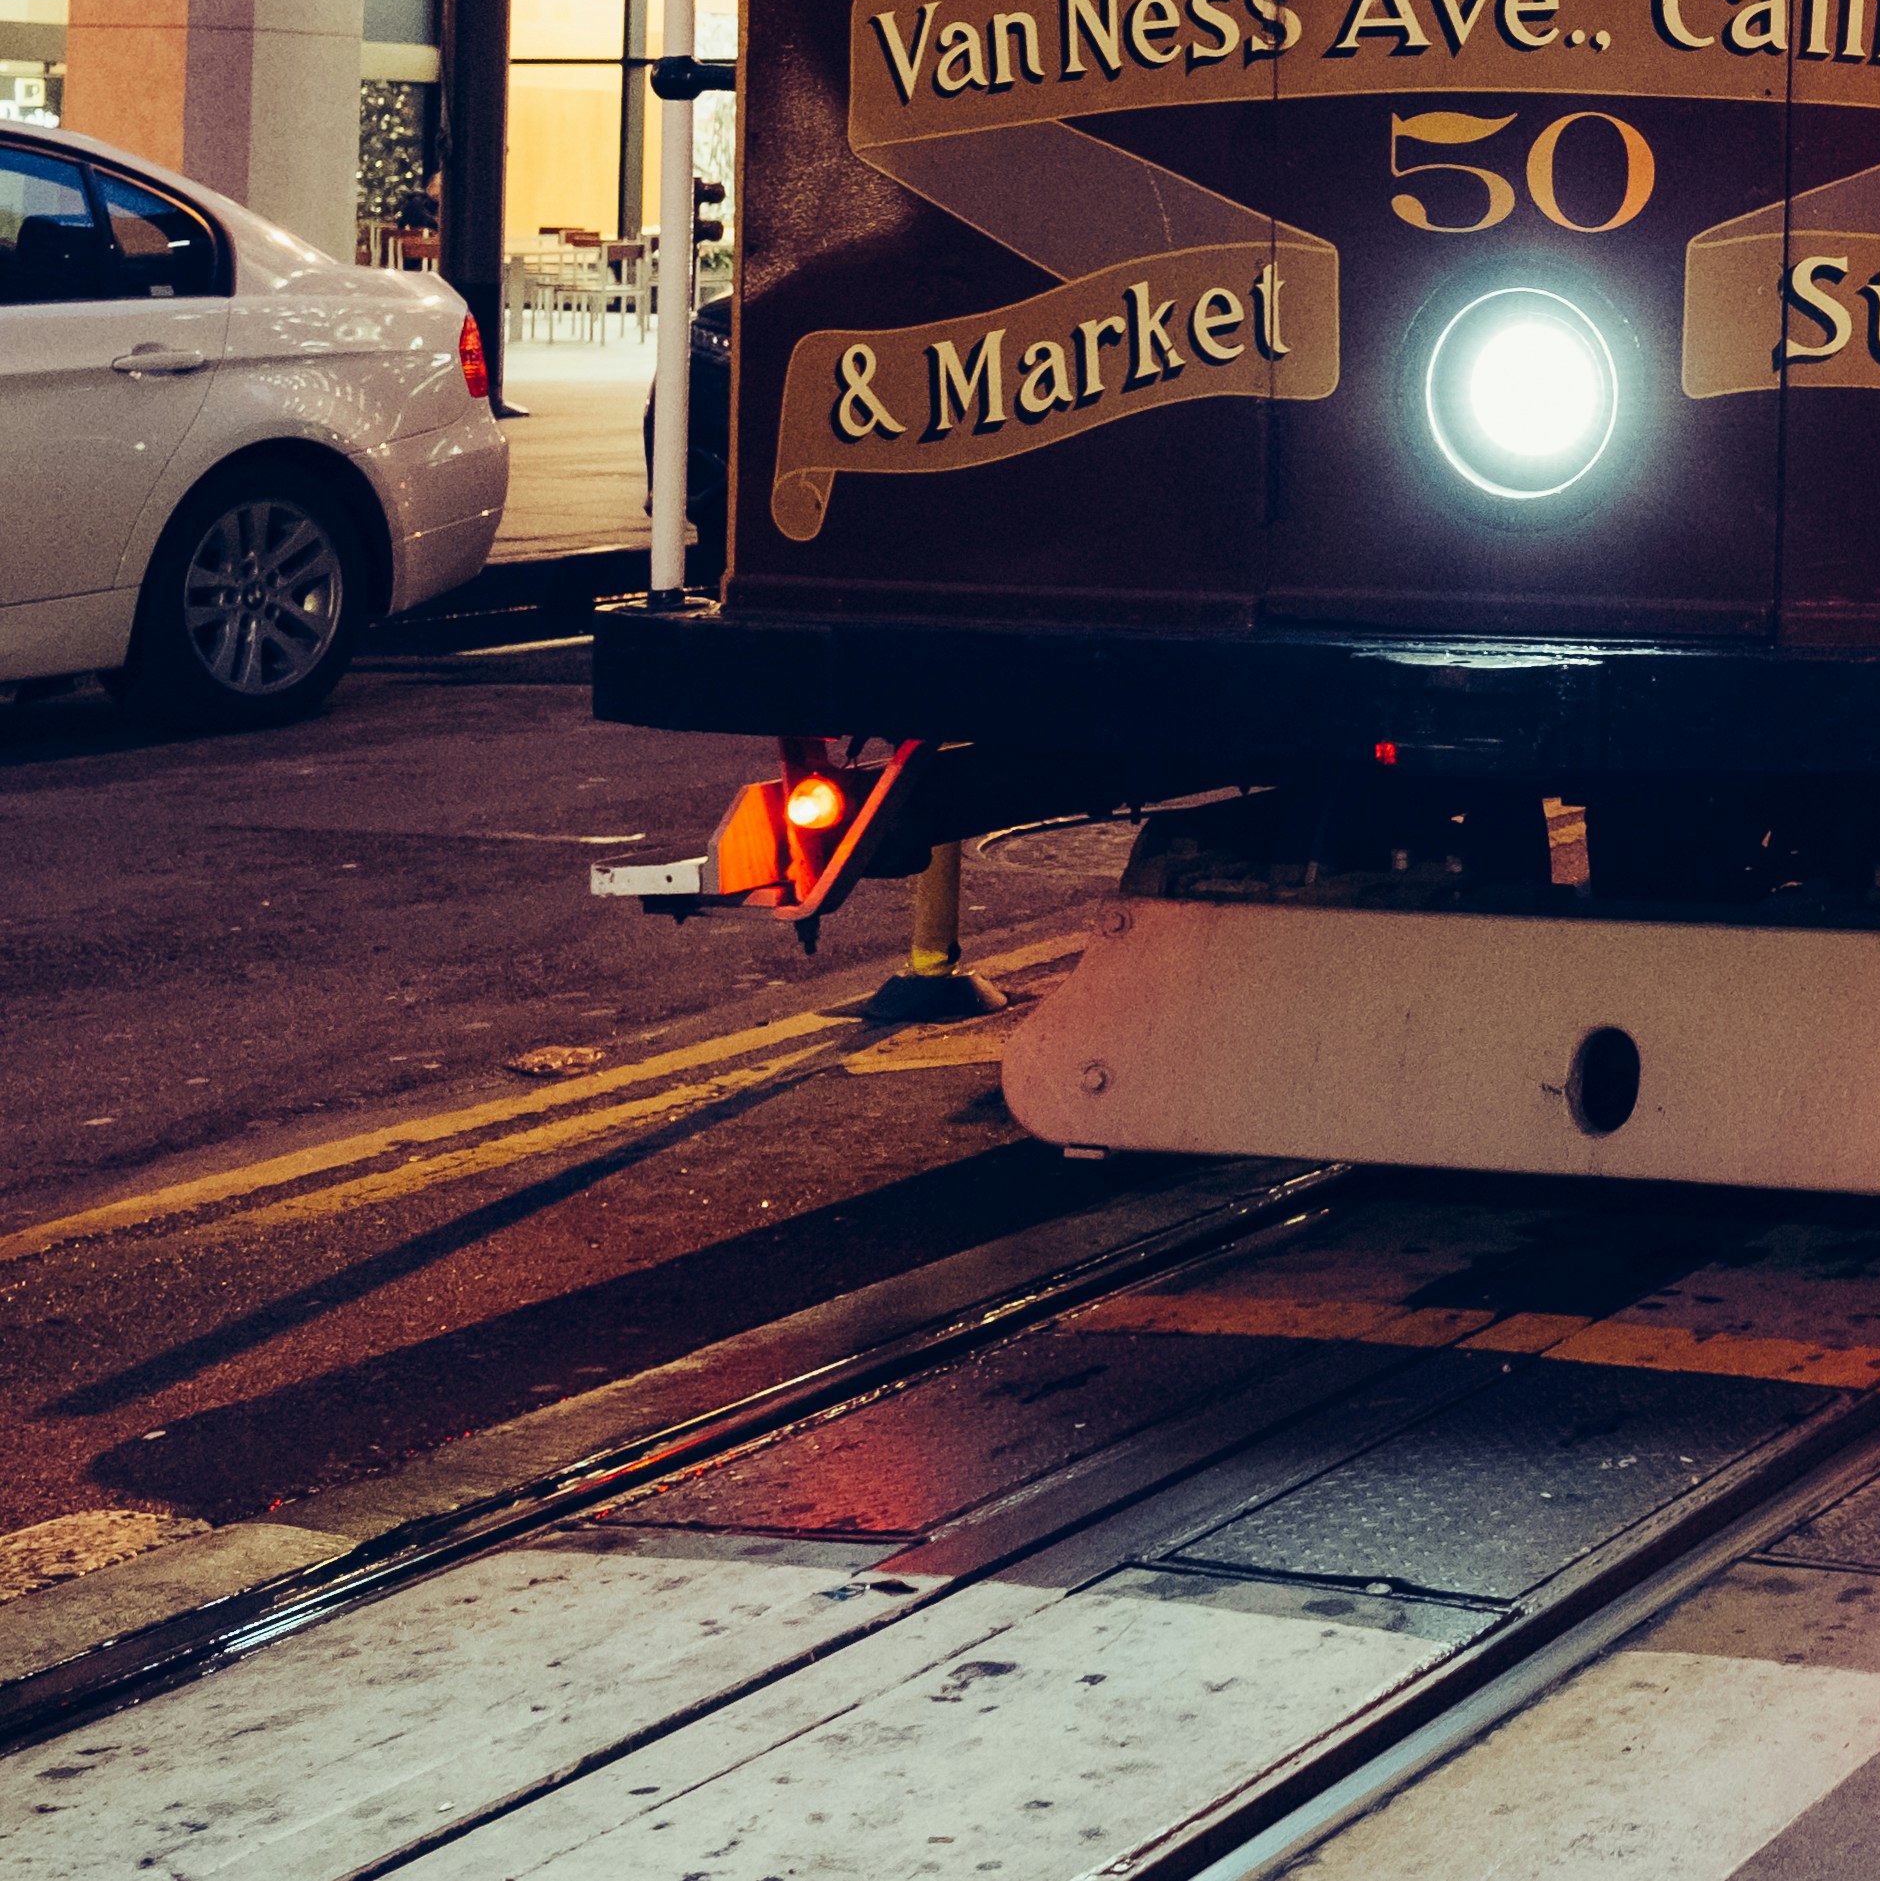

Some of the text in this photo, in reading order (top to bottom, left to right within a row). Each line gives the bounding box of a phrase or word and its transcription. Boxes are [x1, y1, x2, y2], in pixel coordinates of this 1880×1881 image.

[1390, 110, 1656, 234] 50
[838, 260, 1292, 439] & Market
